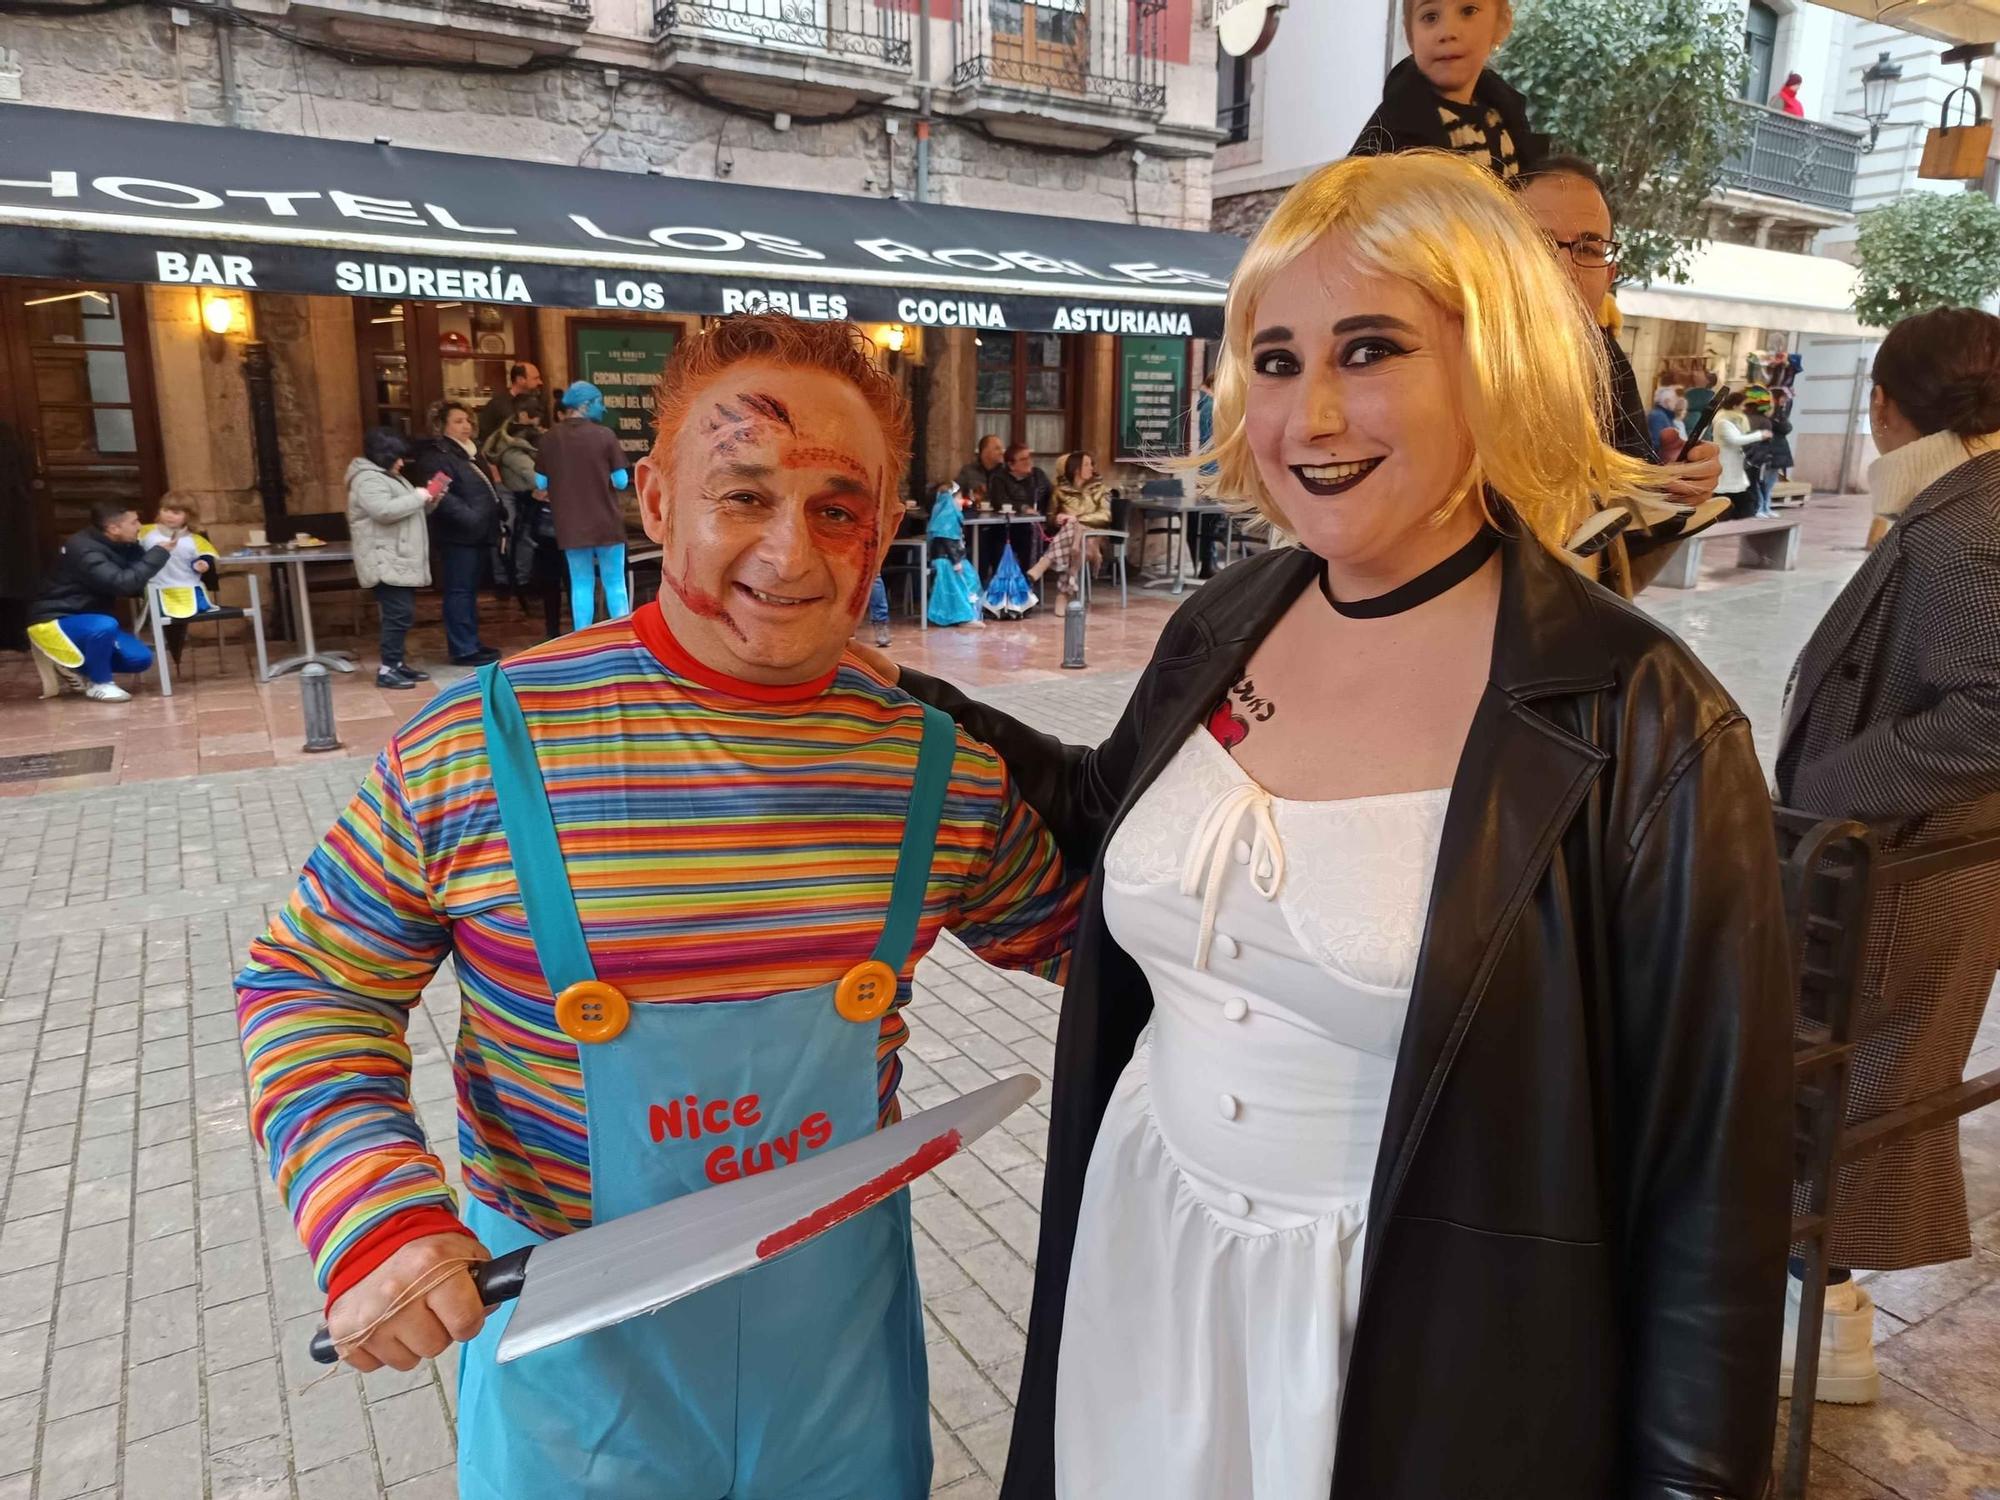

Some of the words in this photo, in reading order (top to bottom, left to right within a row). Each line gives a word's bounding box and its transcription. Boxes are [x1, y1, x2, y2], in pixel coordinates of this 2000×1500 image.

[0, 171, 518, 235] HOTEL
[567, 213, 826, 260] LOS
[854, 238, 1231, 289] ROBLES
[155, 250, 258, 287] BAR
[335, 261, 533, 303] SIDRERÍA
[594, 278, 665, 310] LOS
[722, 288, 849, 320] ROBLES
[898, 299, 1006, 328] COCINA
[1052, 306, 1193, 336] ASTURIANA
[593, 371, 621, 385] COCINA
[603, 394, 626, 409] MENÚ
[627, 395, 641, 409] DEL
[619, 417, 642, 430] TAPAS
[648, 1094, 763, 1144] Nice
[704, 1111, 833, 1185] Guys
